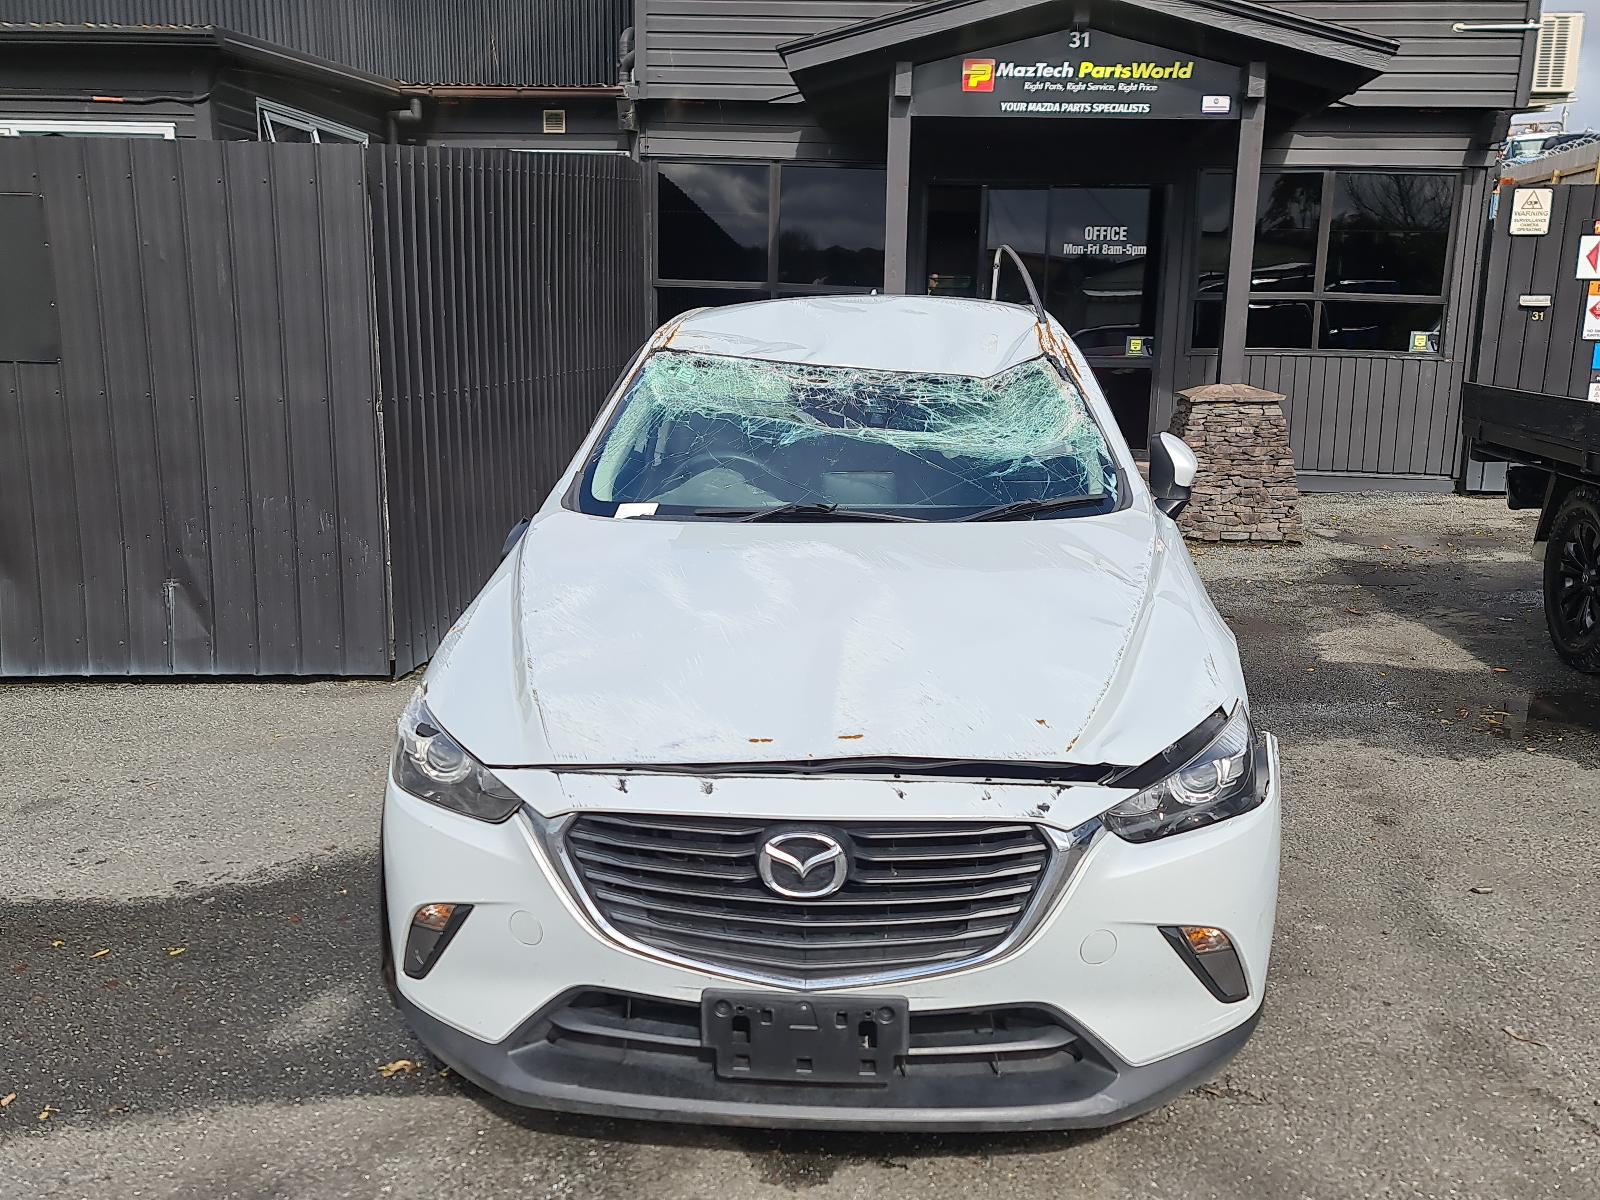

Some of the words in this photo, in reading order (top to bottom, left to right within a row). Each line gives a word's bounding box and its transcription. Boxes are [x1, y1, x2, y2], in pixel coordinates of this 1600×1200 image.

[1068, 31, 1090, 49] 31
[996, 62, 1075, 78] MazTech
[1079, 61, 1195, 79] PartsWorld
[1024, 82, 1044, 93] Right
[1044, 82, 1065, 91] Parts,
[1066, 82, 1087, 93] Right
[1087, 82, 1117, 92] Service,
[1118, 82, 1138, 94] Right
[1138, 82, 1159, 92] Price
[1001, 102, 1027, 112] YOUR
[1027, 102, 1060, 112] MAZDA
[1061, 103, 1092, 113] PARTS
[1092, 103, 1151, 113] SPECIALISTS
[1084, 226, 1128, 241] OFFICE
[1063, 243, 1100, 255] Mon-Fri
[1102, 243, 1147, 257] 8am-5pm
[1531, 311, 1545, 321] 31
